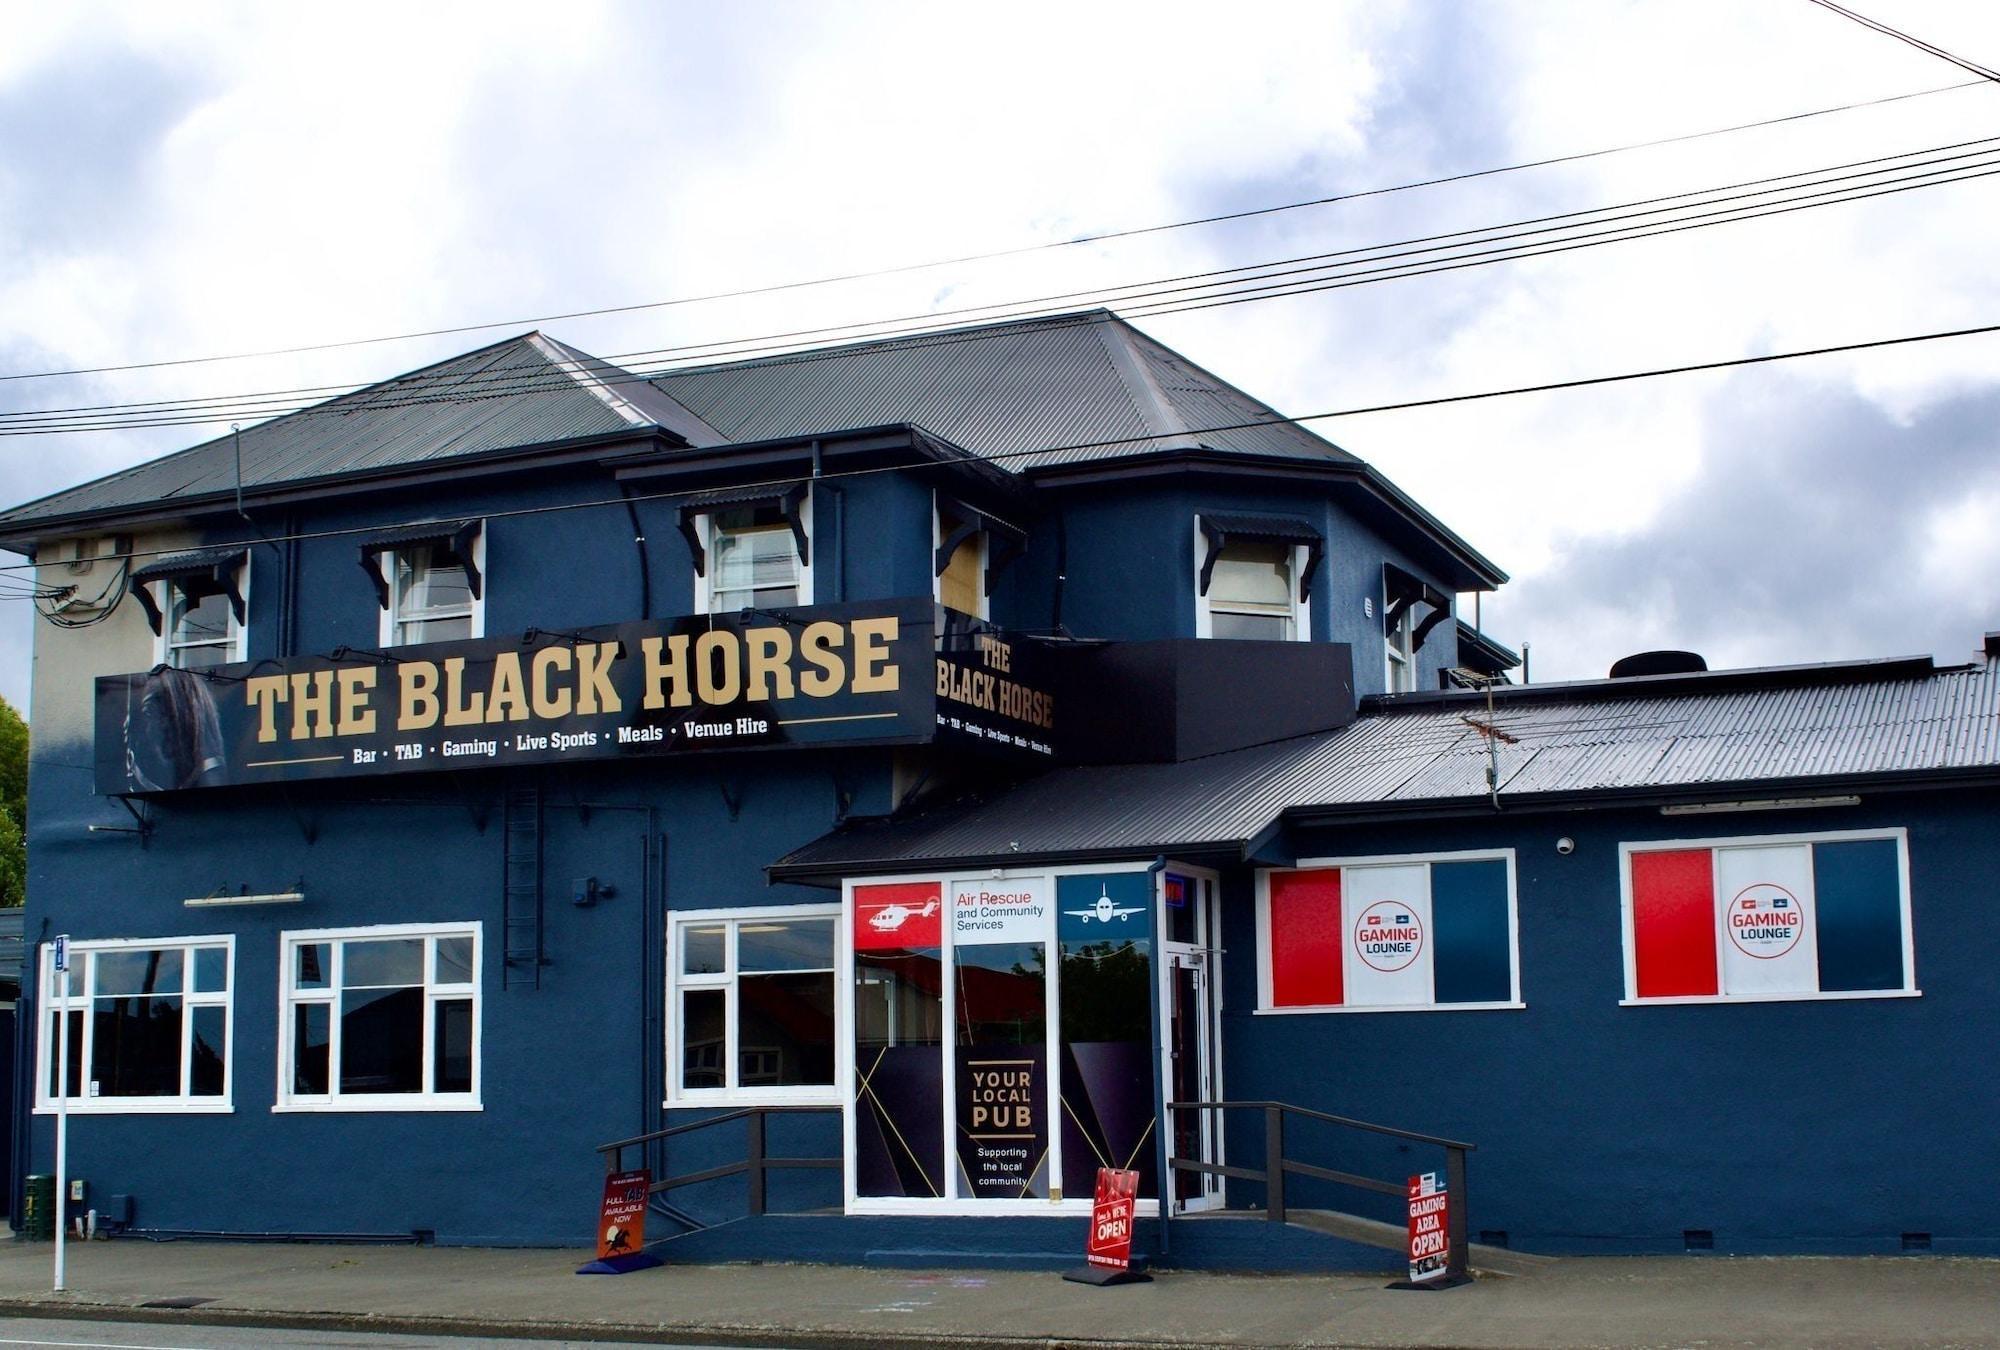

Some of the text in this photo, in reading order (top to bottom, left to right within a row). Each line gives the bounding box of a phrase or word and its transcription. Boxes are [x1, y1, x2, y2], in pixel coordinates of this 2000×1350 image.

[981, 636, 1011, 673] THE
[246, 616, 899, 743] THE BLACK HORSE
[936, 658, 1054, 729] BLACK HORSE
[353, 718, 768, 764] Bar TAB Gaming Live Sports Meals Venue Hire
[957, 892, 1032, 906] Air Rescue
[957, 905, 1044, 919] and Community
[957, 919, 1004, 931] Services
[1733, 912, 1798, 928] GAMING
[1359, 927, 1418, 942] GAMING
[1740, 927, 1791, 940] LOUNGE
[1366, 942, 1412, 954] LOUNGE
[973, 1072, 1031, 1088] YOUR
[973, 1089, 1031, 1102] LOCAL
[973, 1106, 1031, 1128] PUB
[977, 1148, 1027, 1158] Supporting
[983, 1162, 1022, 1171] the local
[978, 1178, 1027, 1187] community
[1409, 1196, 1446, 1218] GAMING
[613, 1215, 631, 1224] NOW
[1416, 1214, 1440, 1234] AREA
[1098, 1218, 1127, 1241] OPEN
[1412, 1230, 1445, 1257] OPEN
